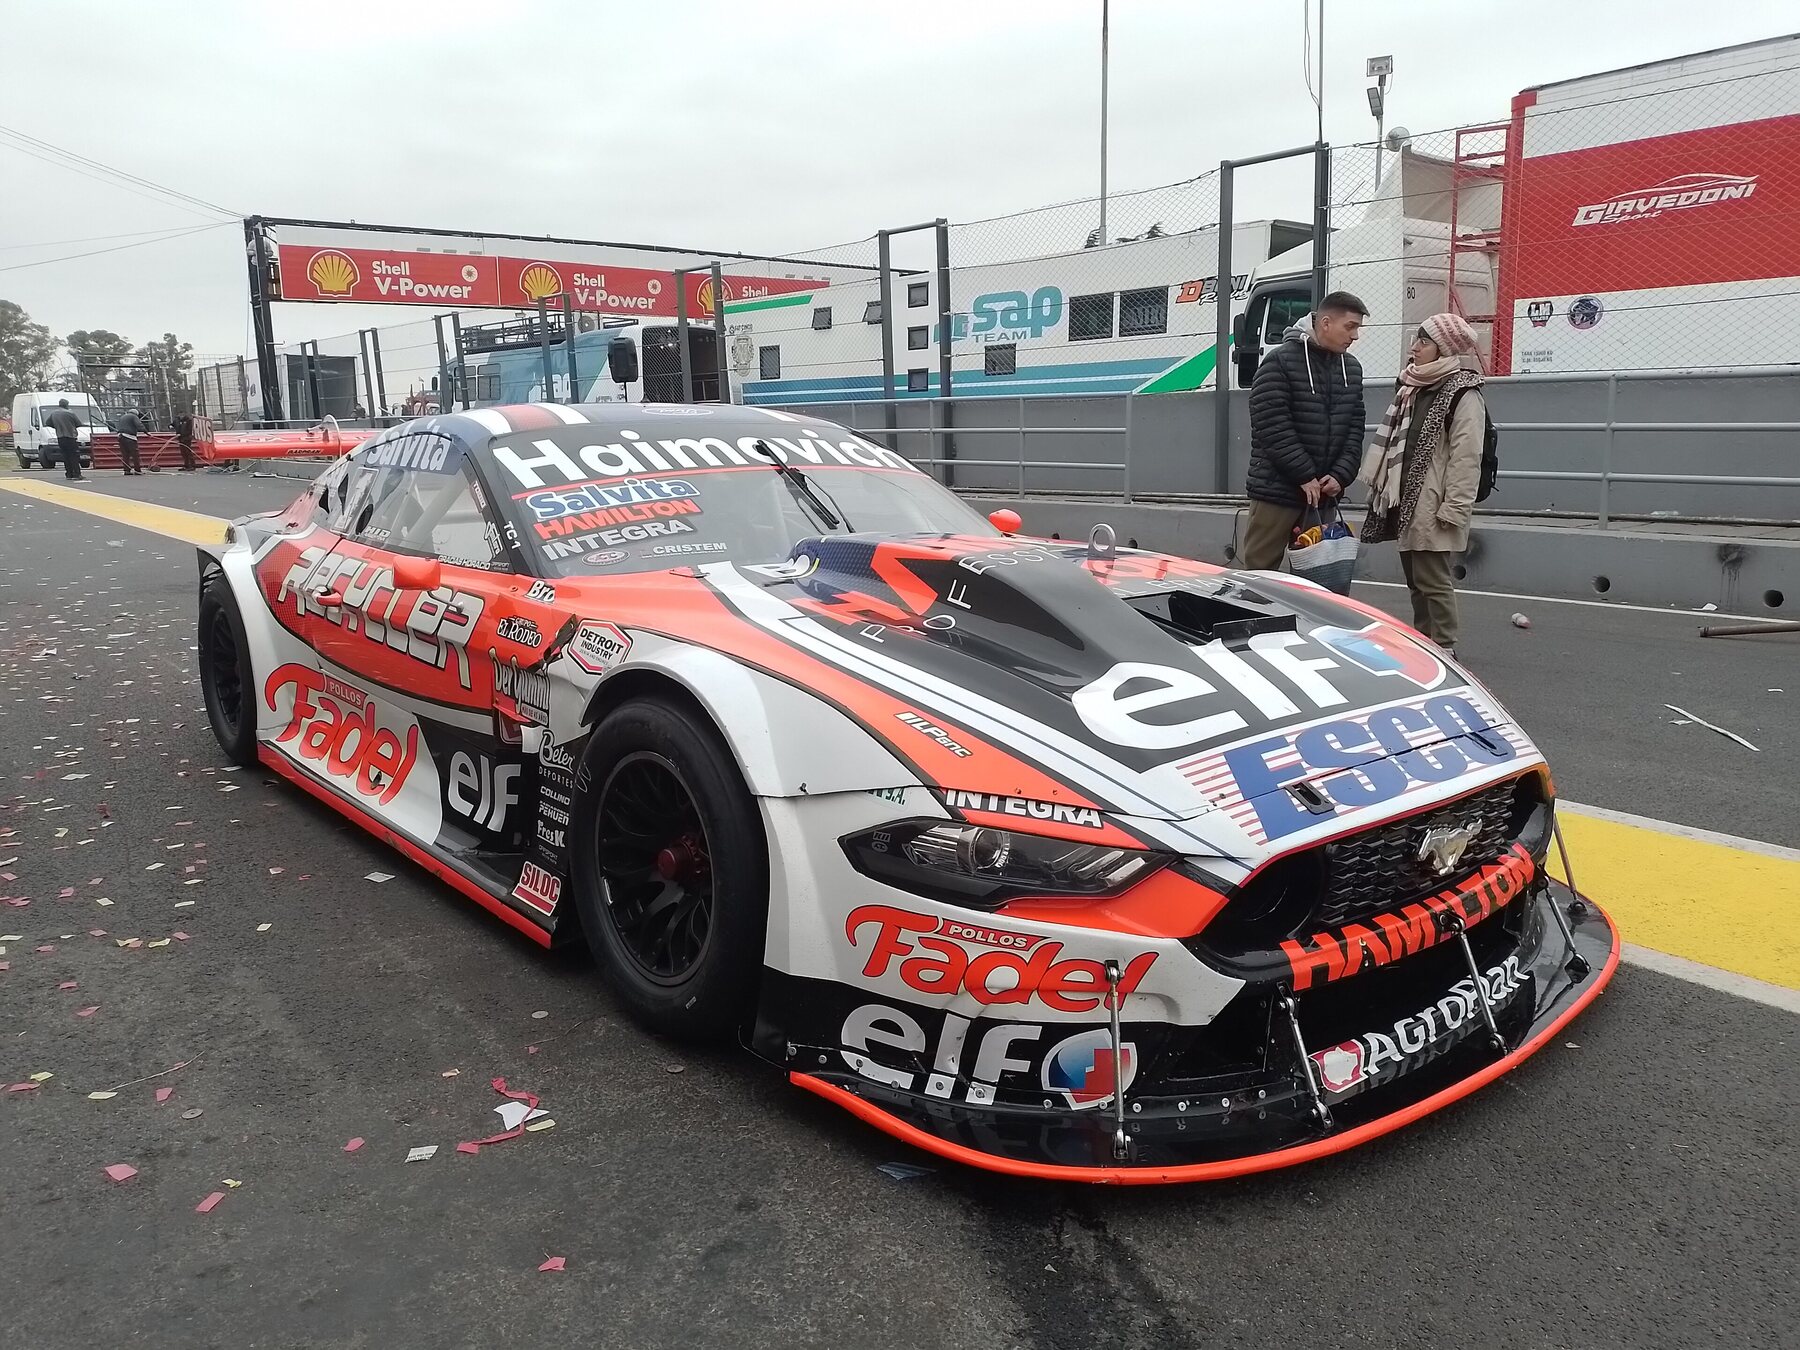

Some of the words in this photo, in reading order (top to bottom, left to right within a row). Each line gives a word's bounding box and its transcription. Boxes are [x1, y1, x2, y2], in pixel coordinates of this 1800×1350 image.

[1572, 183, 1757, 227] GIAVEDONI
[372, 260, 410, 276] Shell
[373, 276, 472, 299] V-Power
[573, 273, 605, 288] Shell
[574, 287, 656, 310] V-Power
[742, 285, 769, 298] Shell
[972, 285, 1063, 338] sap
[1406, 286, 1416, 300] 80
[972, 330, 1028, 343] TEAM
[367, 419, 453, 471] Salvita
[493, 428, 916, 488] Haimovich
[528, 476, 700, 520] Salvita
[534, 498, 702, 540] HAMILTON
[541, 519, 694, 560] INTEGRA
[653, 541, 728, 555] CRISTEM
[580, 627, 624, 655] DETROIT
[580, 640, 613, 661] INDUSTRY
[329, 680, 363, 707] POLLOS
[1072, 631, 1346, 750] elf
[264, 662, 419, 806] Fadel
[539, 730, 576, 774] Beter
[538, 765, 574, 789] DEPORTES
[1224, 694, 1518, 844] ESCO
[447, 750, 522, 833] elf
[945, 788, 1104, 829] INTEGRA
[521, 863, 560, 902] SILOC
[948, 924, 1029, 948] POLLOS
[844, 904, 1161, 1013] Fadel
[841, 1004, 1043, 1105] elf
